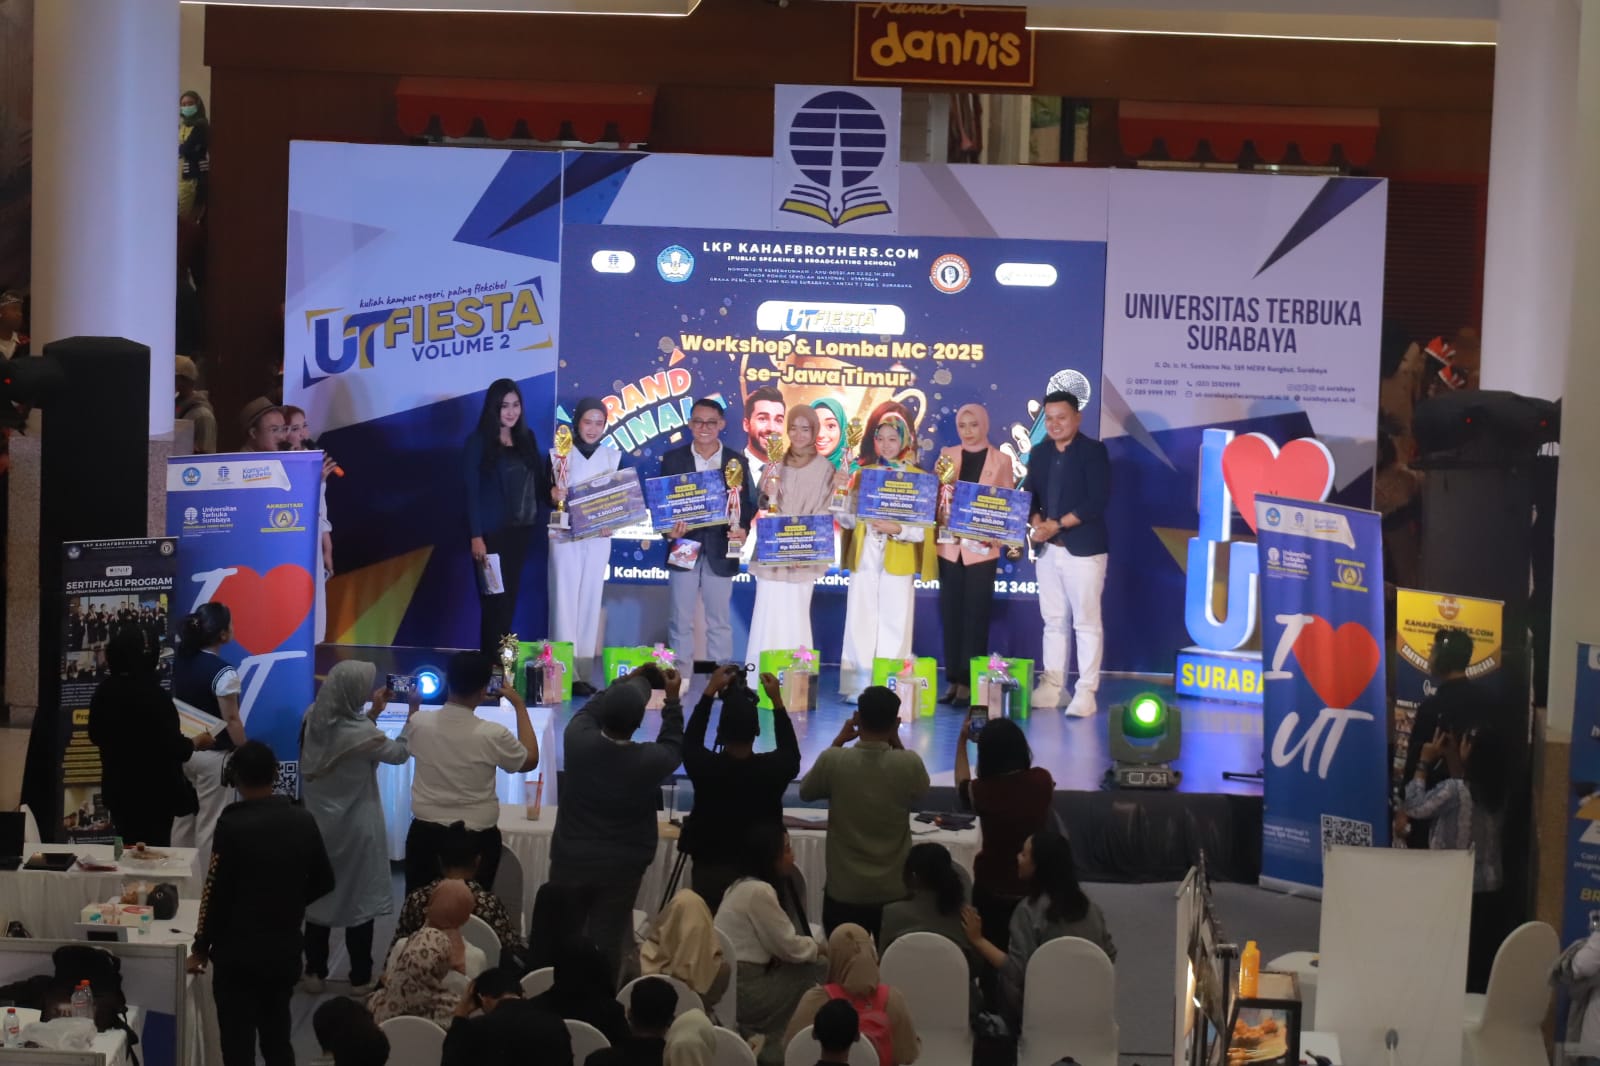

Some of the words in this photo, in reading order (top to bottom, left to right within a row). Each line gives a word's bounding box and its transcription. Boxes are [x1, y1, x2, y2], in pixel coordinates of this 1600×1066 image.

[870, 22, 1021, 70] dannis
[703, 242, 732, 252] LKP
[739, 242, 919, 259] KAHAFBROTHERS.COM
[359, 297, 384, 308] kuliah
[386, 294, 417, 305] kampus
[447, 286, 472, 299] paling
[474, 280, 508, 295] fleksibel
[384, 289, 544, 349] FIESTA
[814, 310, 875, 327] FIESTA
[1125, 293, 1260, 323] UNIVERSITAS
[1266, 298, 1362, 326] TERBUKA
[412, 336, 494, 362] VOLUME
[500, 334, 510, 349] 2
[681, 334, 792, 360] Workshop
[795, 339, 811, 355] &
[816, 340, 888, 358] Lomba
[892, 342, 927, 359] MC
[933, 343, 984, 361] 2025
[1187, 325, 1297, 353] SURABAYA
[746, 366, 842, 385] se-Jawa
[843, 367, 910, 386] Timur
[602, 368, 692, 426] RAND
[280, 512, 289, 522] A
[66, 580, 123, 590] SERTIFIKASI
[125, 577, 173, 587] PROGRAM
[1271, 707, 1375, 779] UT
